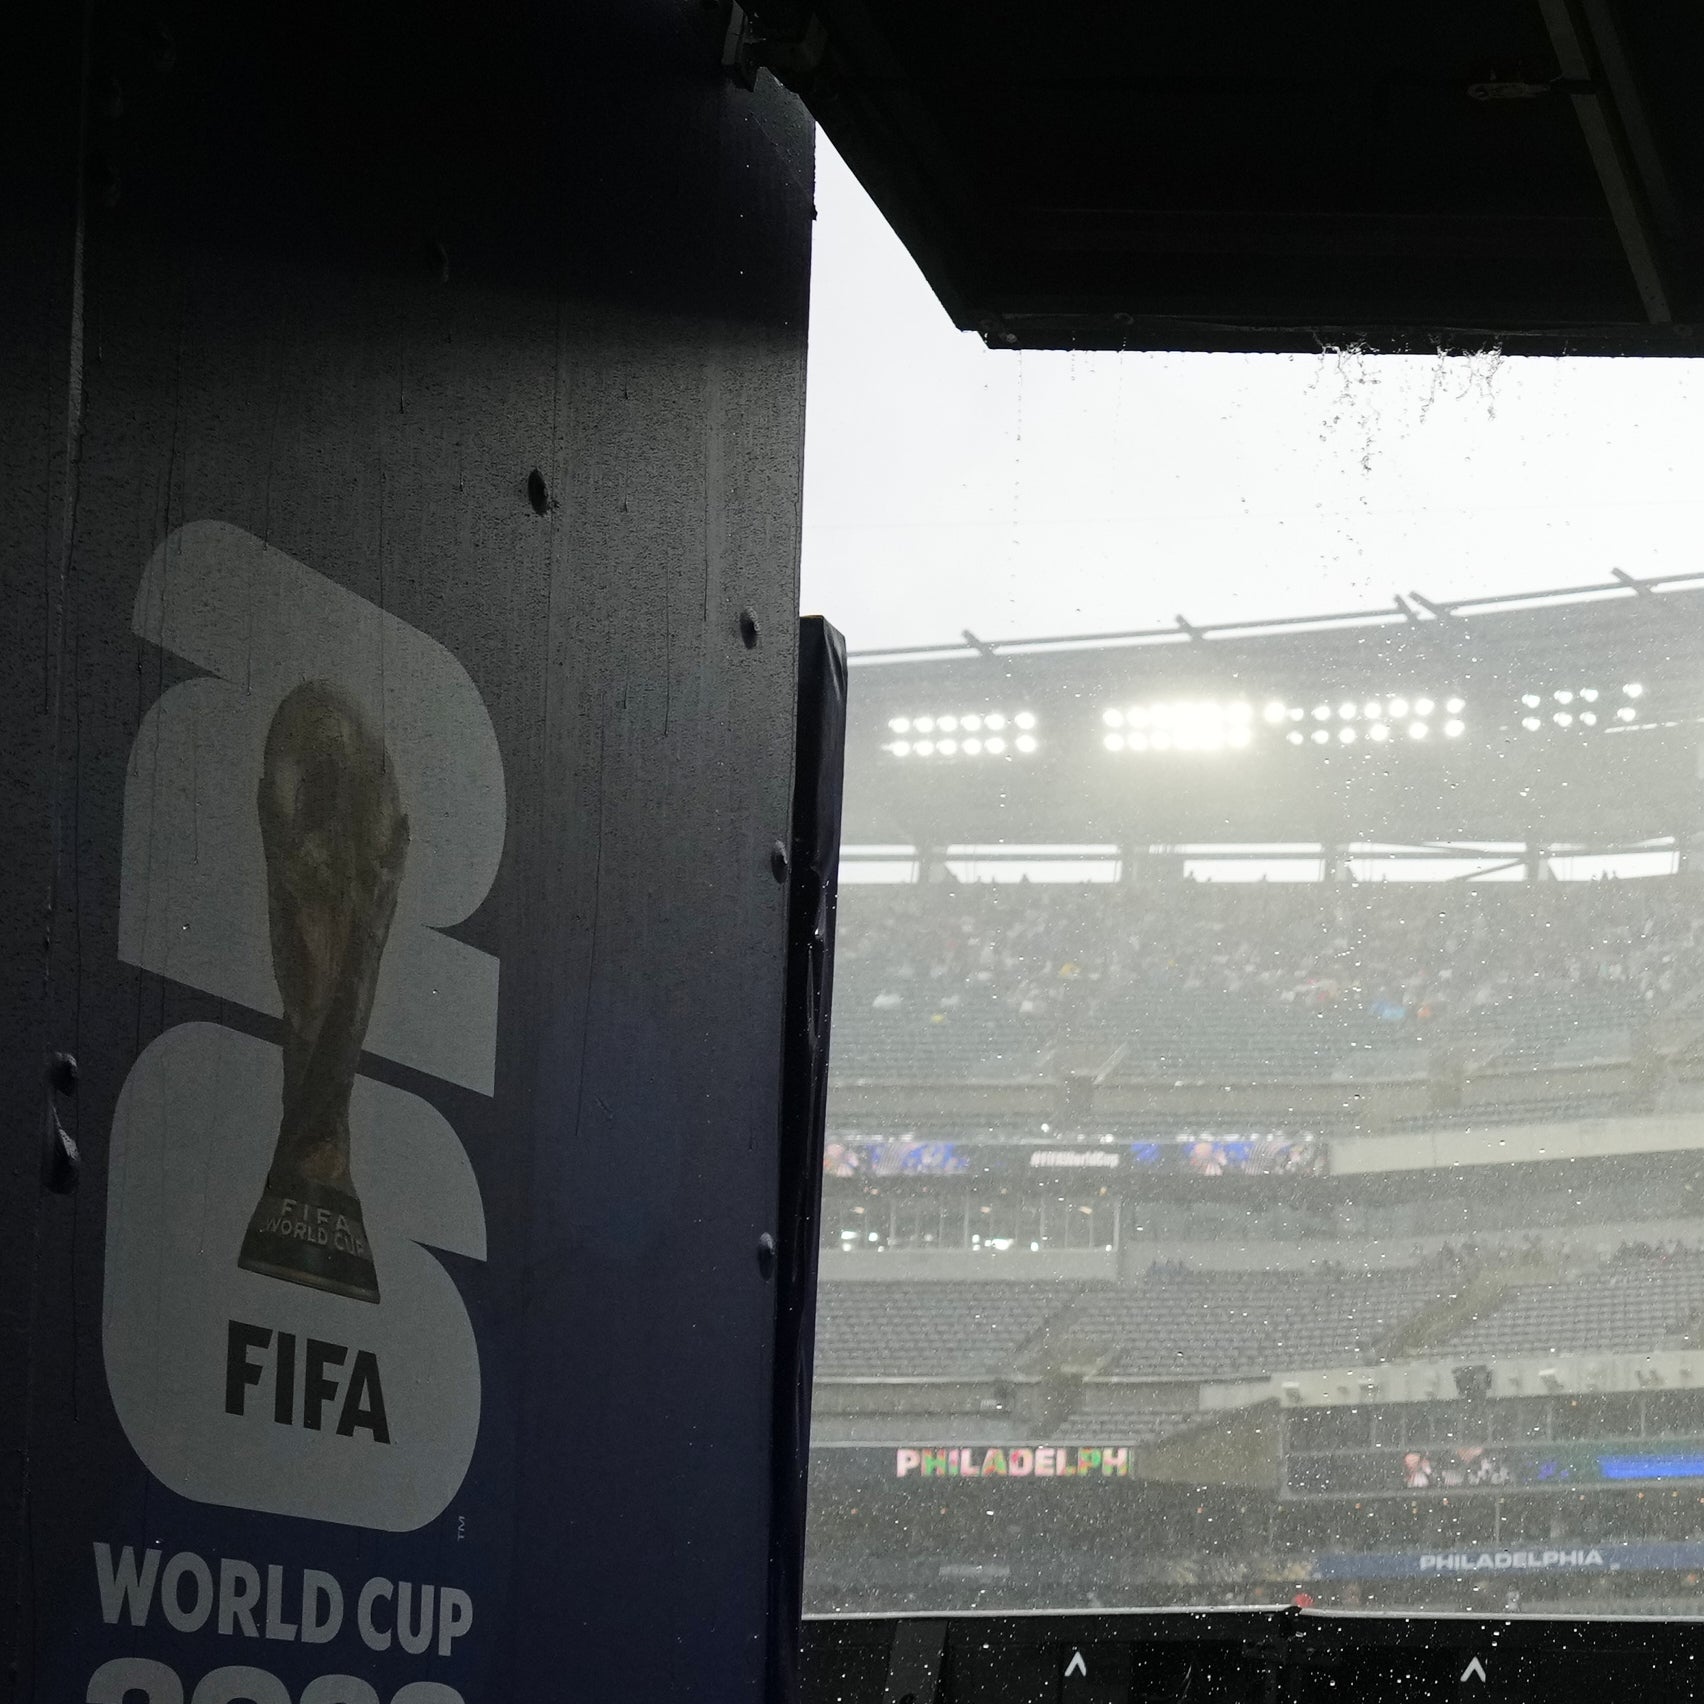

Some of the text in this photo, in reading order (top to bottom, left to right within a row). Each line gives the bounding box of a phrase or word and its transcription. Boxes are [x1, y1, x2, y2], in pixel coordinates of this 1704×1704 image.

[281, 1198, 350, 1233] FIFA
[265, 1217, 365, 1257] WORLD CUP
[225, 1319, 391, 1445] FIFA
[1420, 1549, 1604, 1571] PHILADELPHIA
[92, 1541, 474, 1657] WORLD CUP
